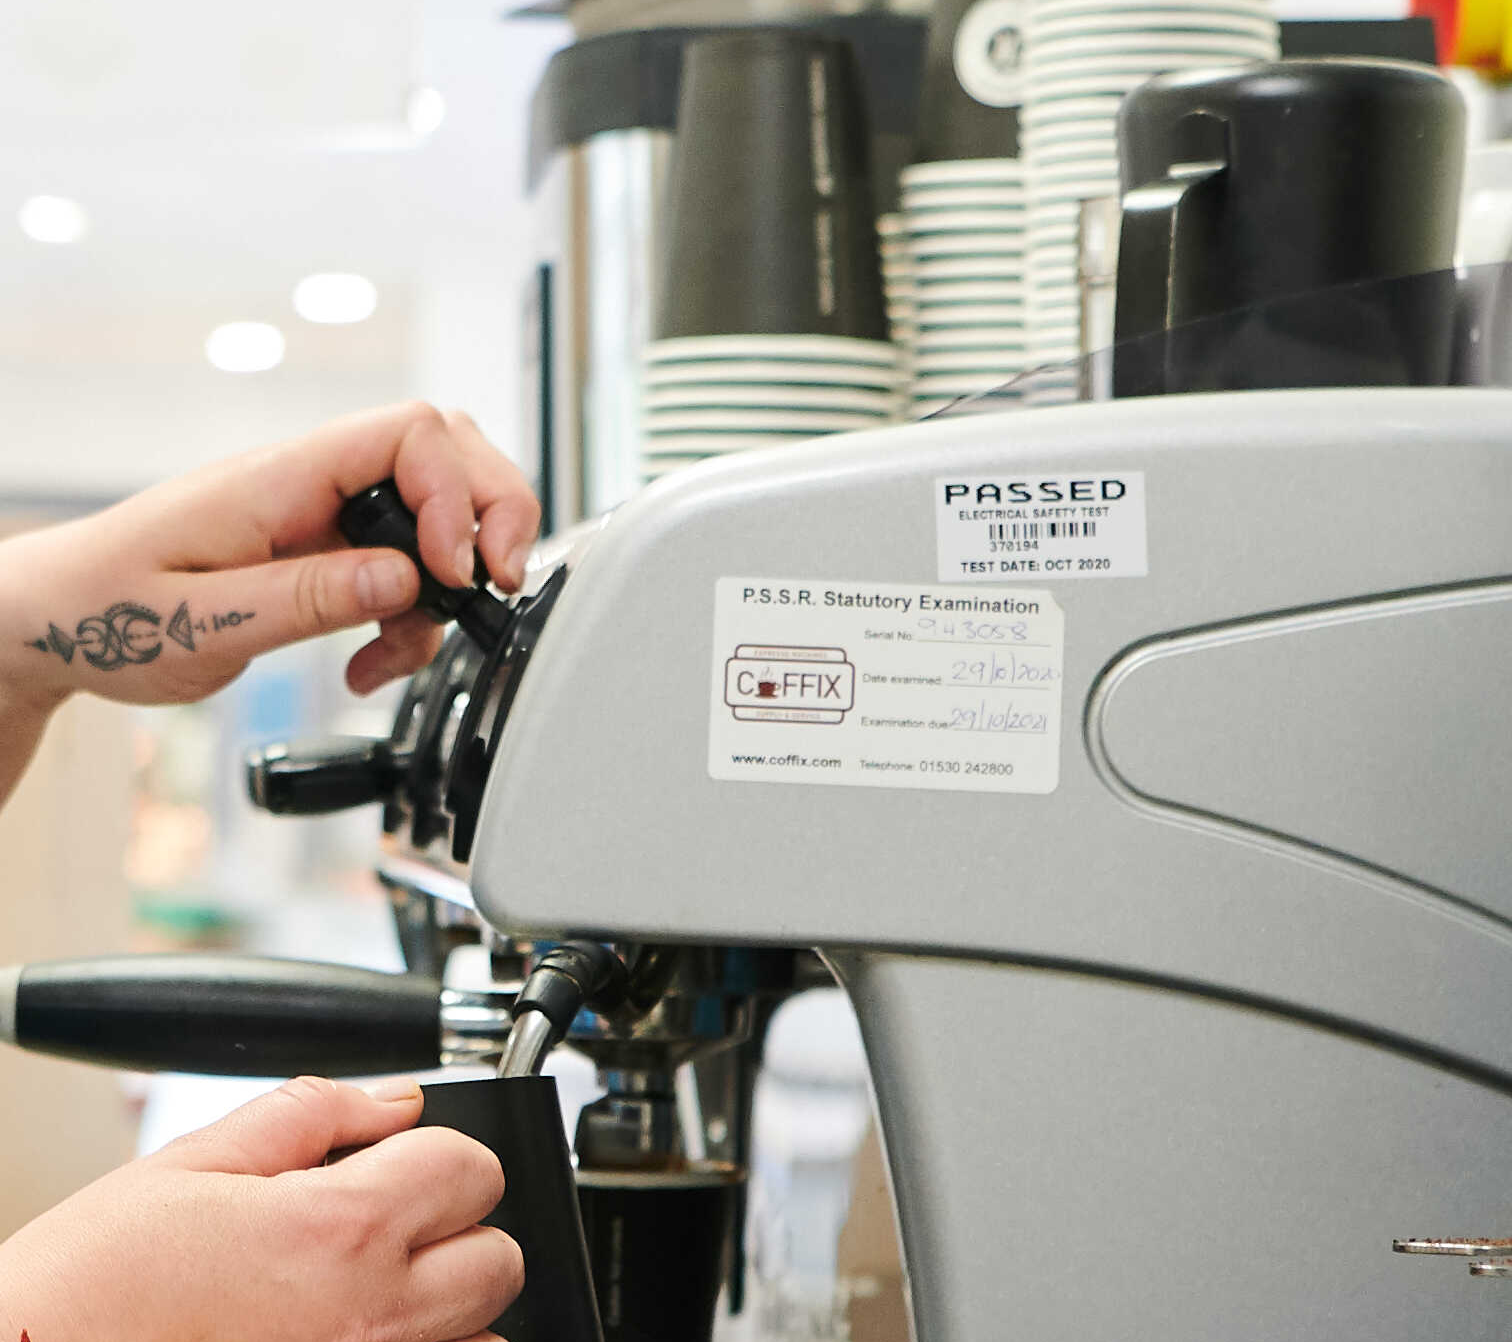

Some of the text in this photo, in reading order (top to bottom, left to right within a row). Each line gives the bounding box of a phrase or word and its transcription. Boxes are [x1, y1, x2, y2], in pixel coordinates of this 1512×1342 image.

[944, 479, 1127, 505] PASSED
[959, 506, 1110, 521] ELECTRICAL SAFETY TEST
[960, 558, 1112, 573] TEST DATE: OCT 2020
[742, 587, 1040, 615] P.S.S.R. Statutory Examination
[864, 630, 894, 641] Serial
[862, 673, 888, 685] Date
[731, 754, 842, 769] www.coffix.com
[919, 761, 961, 774] 01530
[965, 763, 1014, 776] 242800
